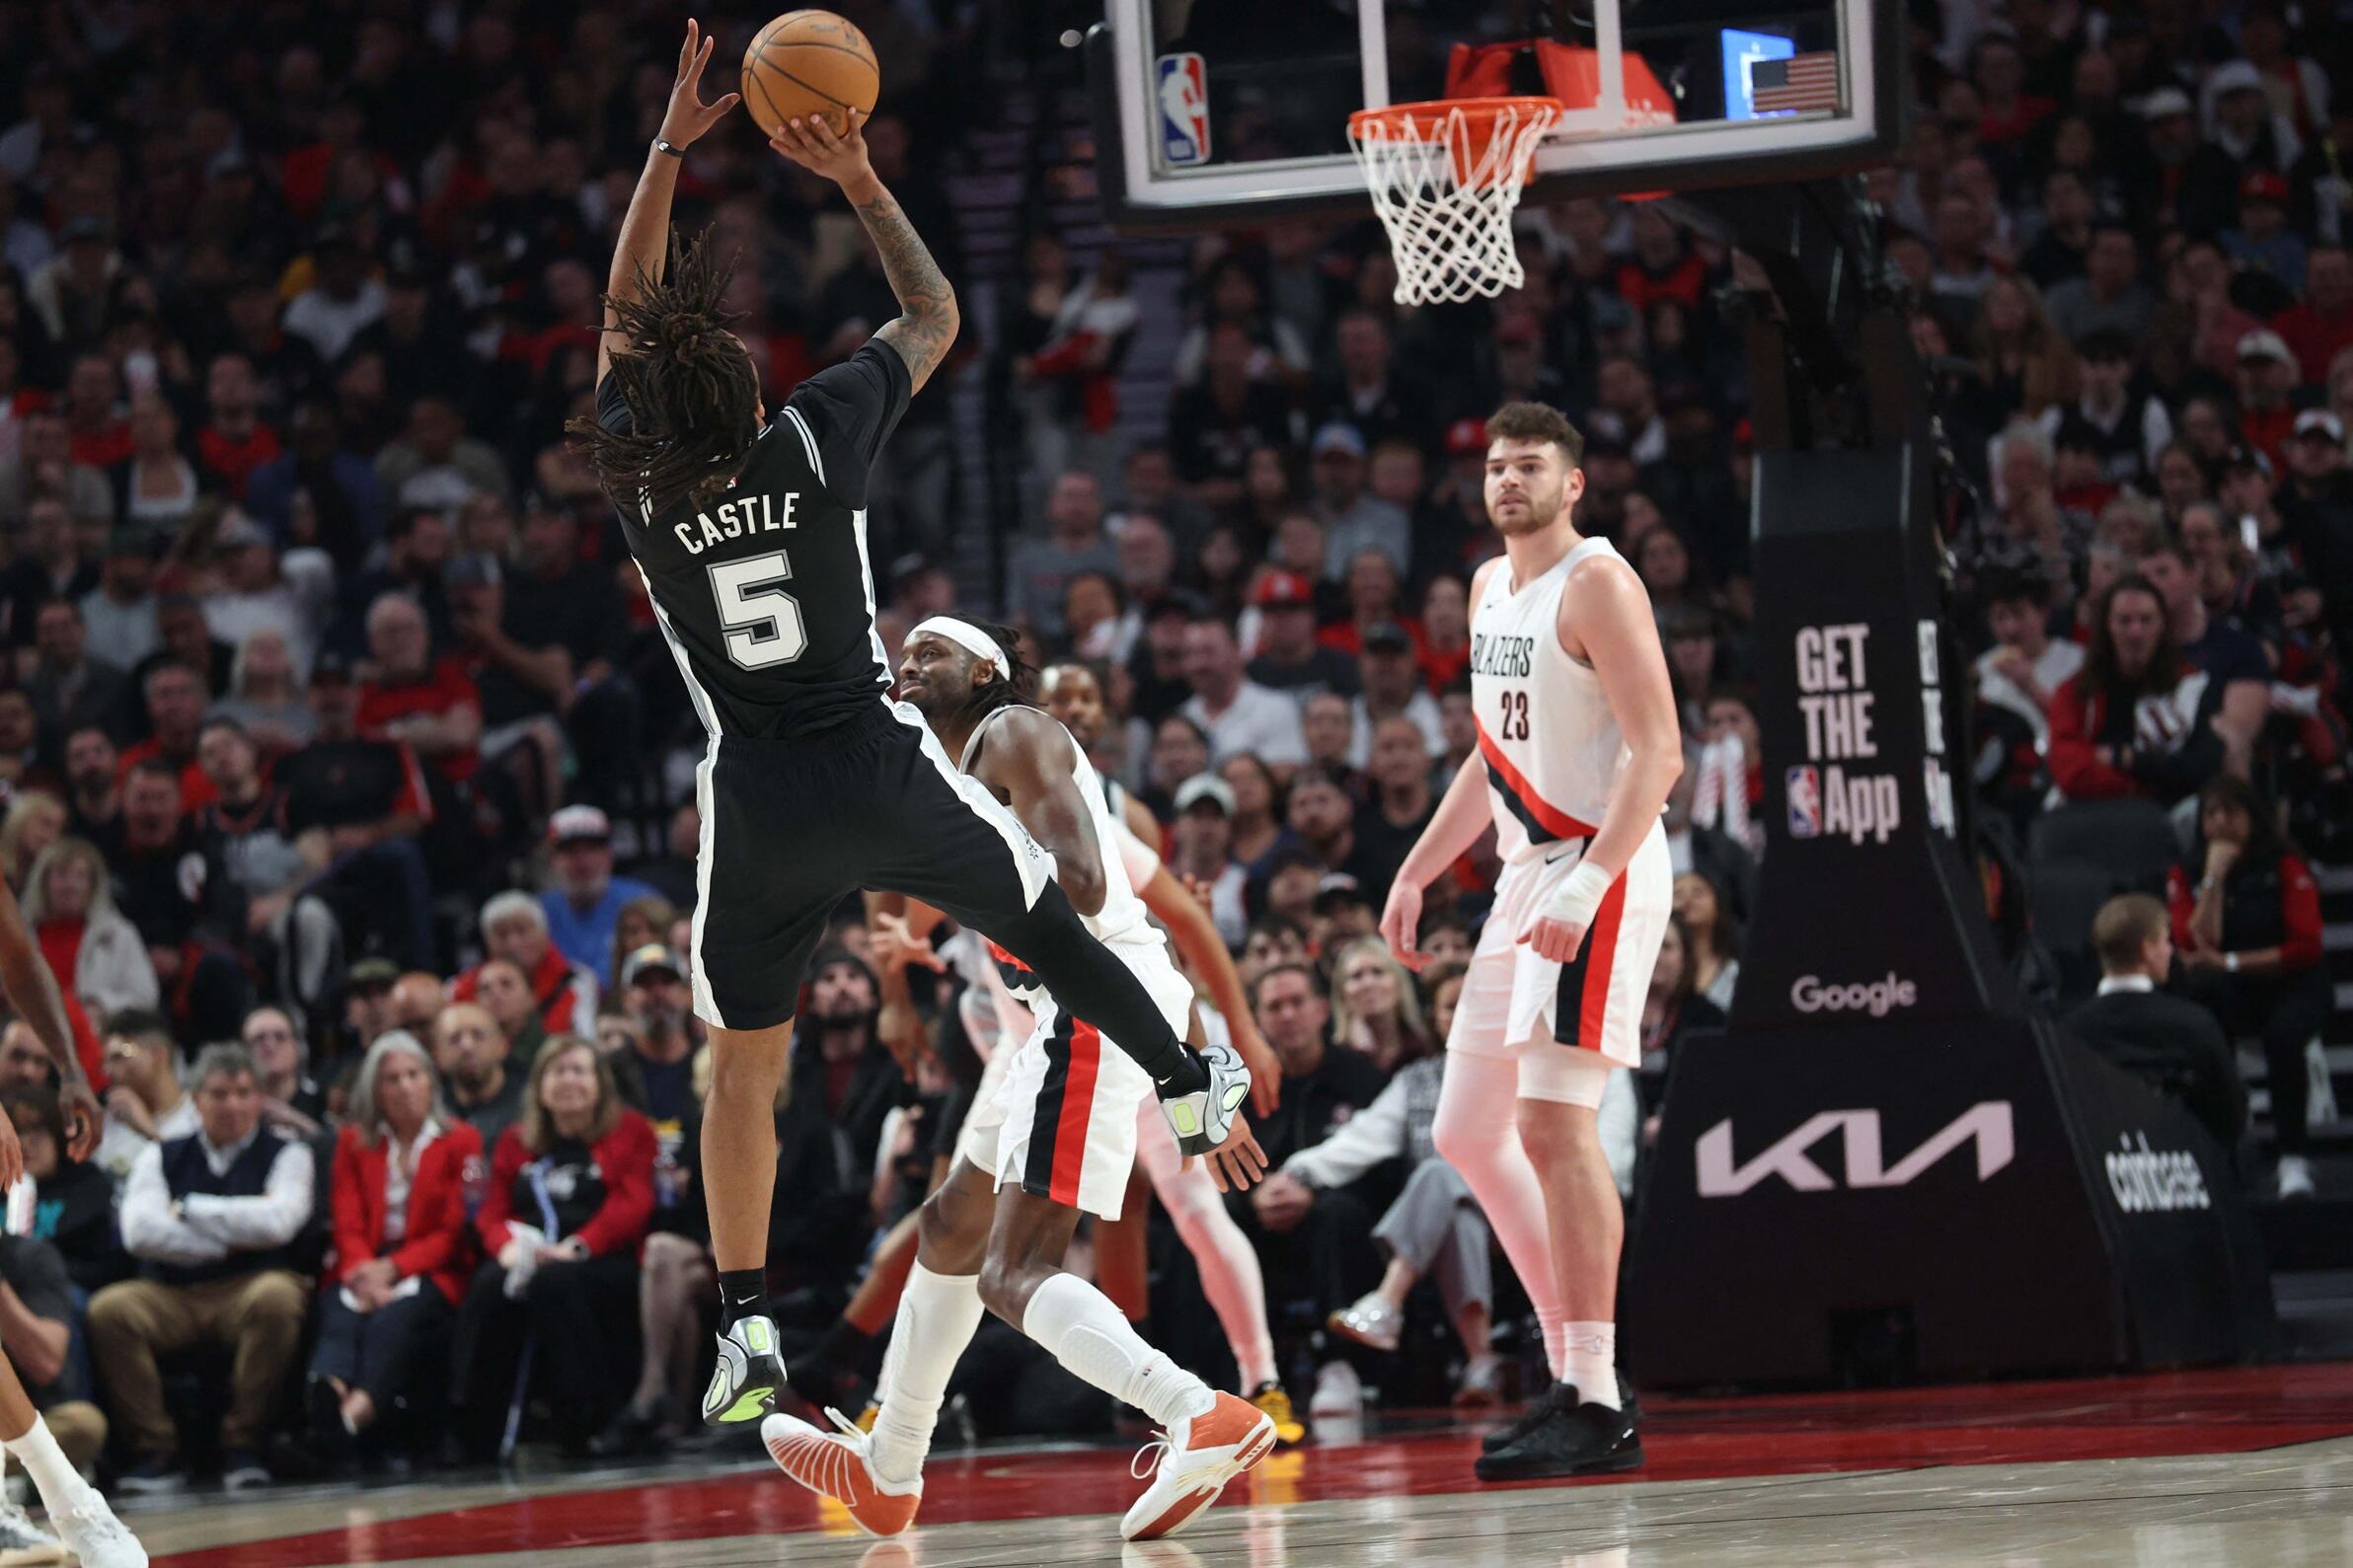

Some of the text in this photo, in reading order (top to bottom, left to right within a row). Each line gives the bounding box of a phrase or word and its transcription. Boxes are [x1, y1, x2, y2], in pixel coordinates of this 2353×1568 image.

[674, 492, 799, 555] CASTLE
[706, 549, 808, 672] 5
[1471, 634, 1534, 678] BLAZERS
[1795, 623, 1869, 692] GET
[1501, 691, 1530, 741] 23
[1798, 692, 1877, 761] THE
[1826, 766, 1900, 846] App
[1791, 970, 1917, 1018] Google
[1695, 1100, 2015, 1198] KIA
